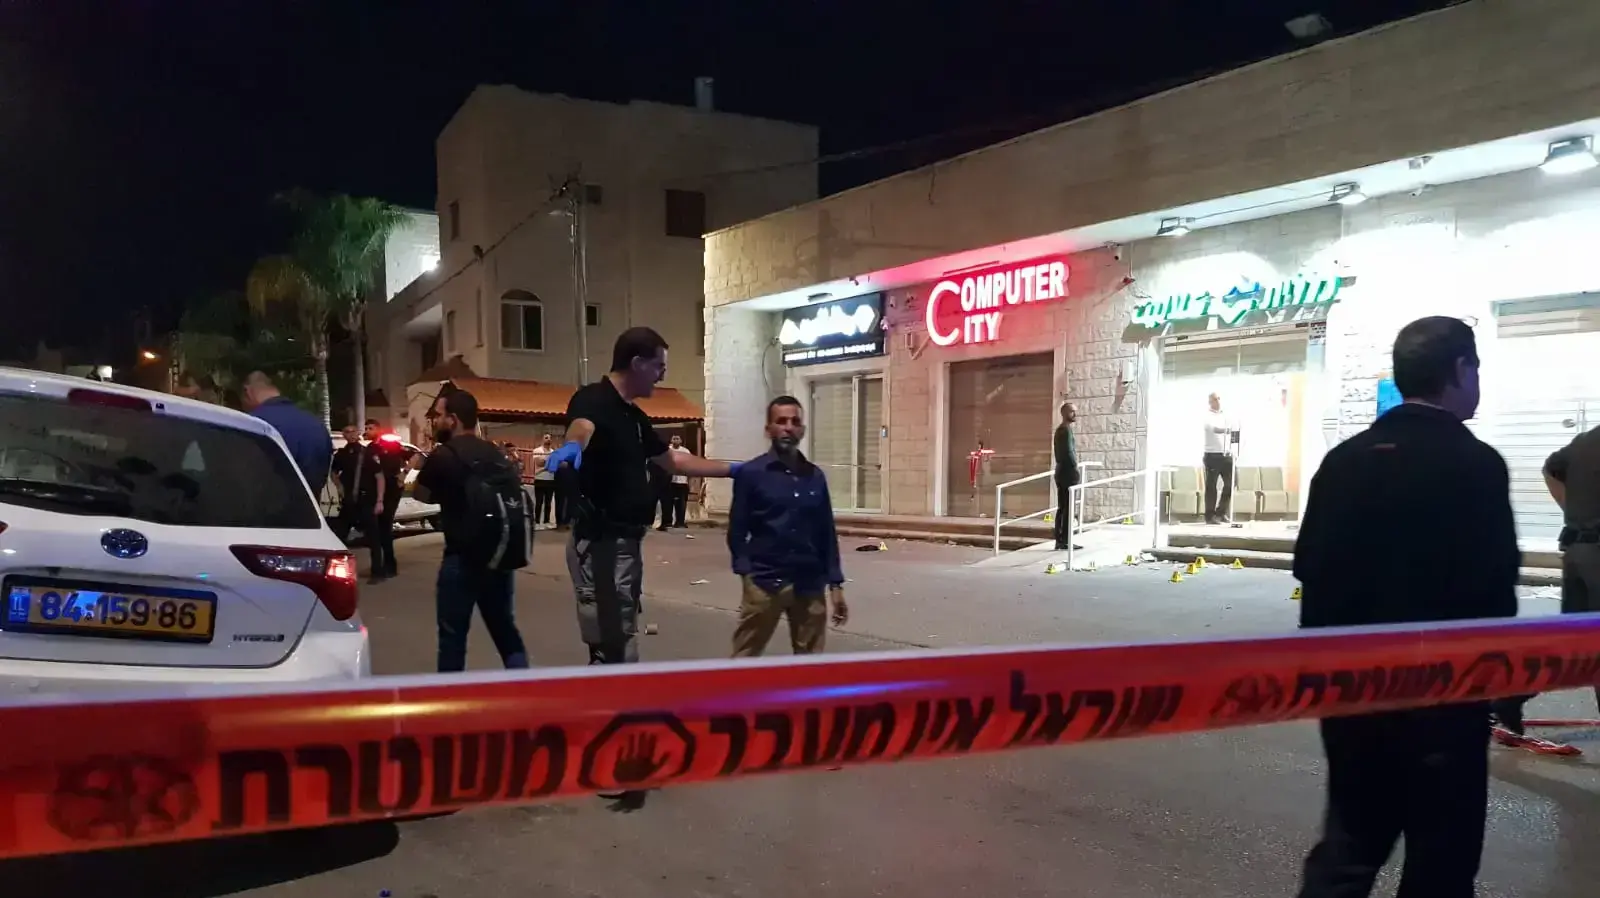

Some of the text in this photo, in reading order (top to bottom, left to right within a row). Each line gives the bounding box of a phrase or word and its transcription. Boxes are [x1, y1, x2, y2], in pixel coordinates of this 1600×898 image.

[709, 702, 896, 776] מעבר
[900, 696, 994, 757] אין
[1002, 669, 1184, 748] ישראל
[211, 723, 567, 829] משטרת
